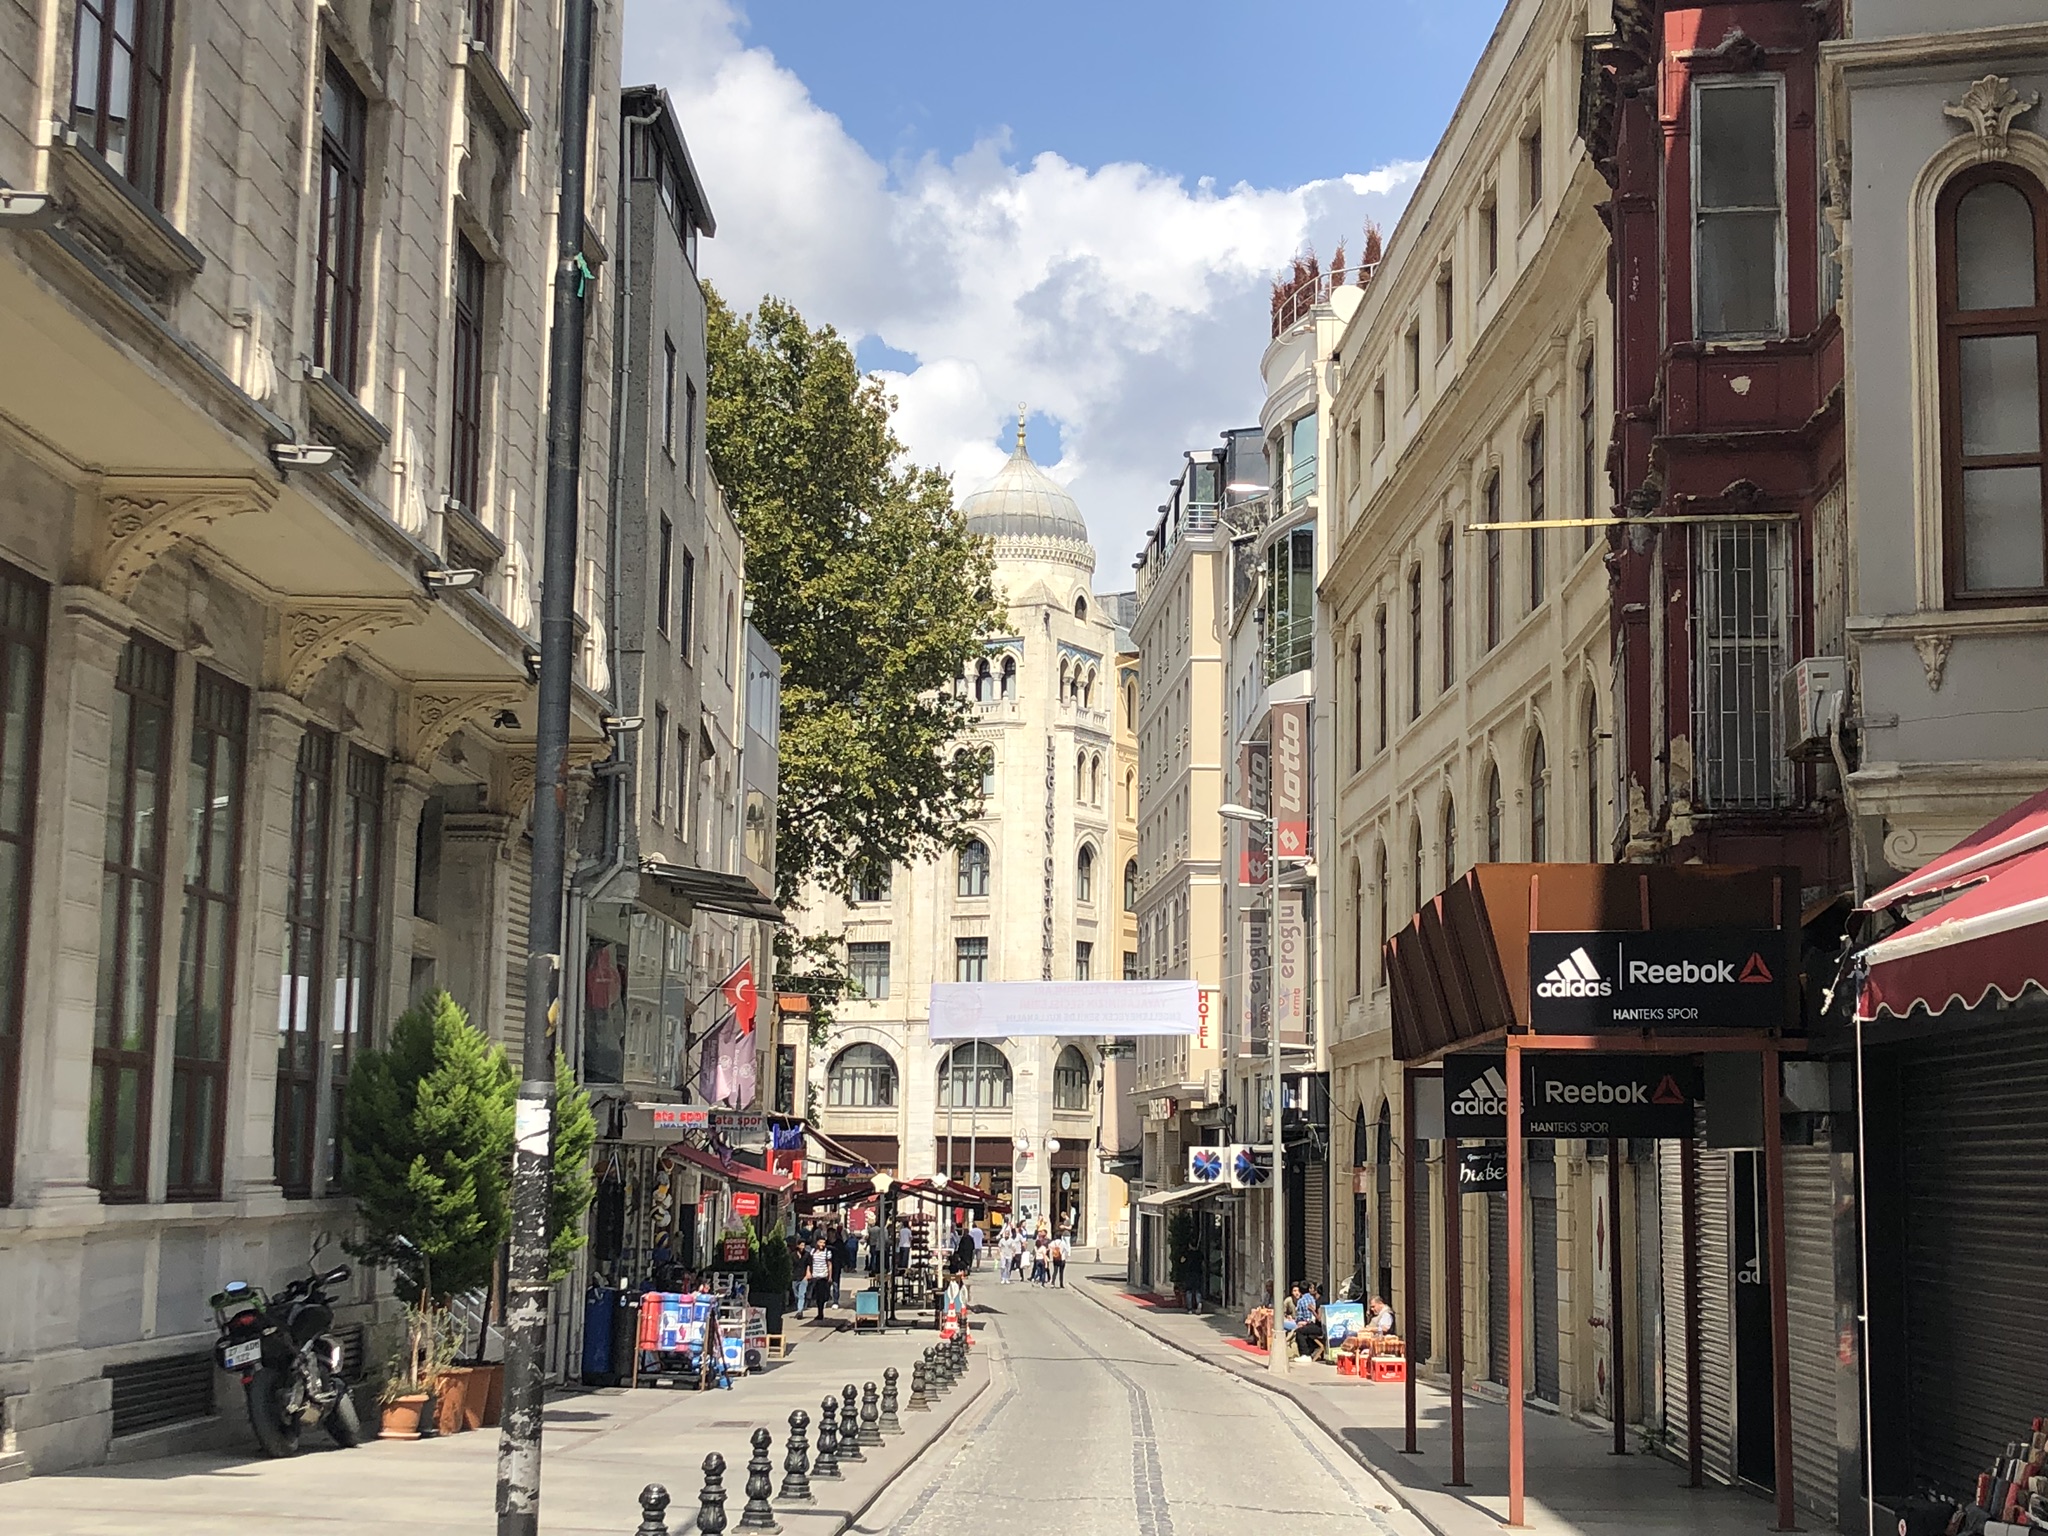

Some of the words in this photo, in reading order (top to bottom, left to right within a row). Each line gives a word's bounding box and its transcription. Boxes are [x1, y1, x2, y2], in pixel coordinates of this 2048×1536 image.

[1280, 712, 1301, 812] lotto
[1536, 978, 1612, 997] adidas
[1629, 960, 1735, 984] Reebok
[1198, 991, 1209, 1048] HOTEL
[1613, 1008, 1664, 1020] HANTEKS
[1667, 1008, 1698, 1020] SPOR
[1545, 1080, 1649, 1104] Reebok
[654, 1111, 675, 1122] ata
[679, 1111, 708, 1123] spor
[715, 1115, 734, 1125] ata
[737, 1115, 763, 1127] spor
[1530, 1122, 1577, 1133] HANTEKS
[1580, 1122, 1609, 1133] SPOR
